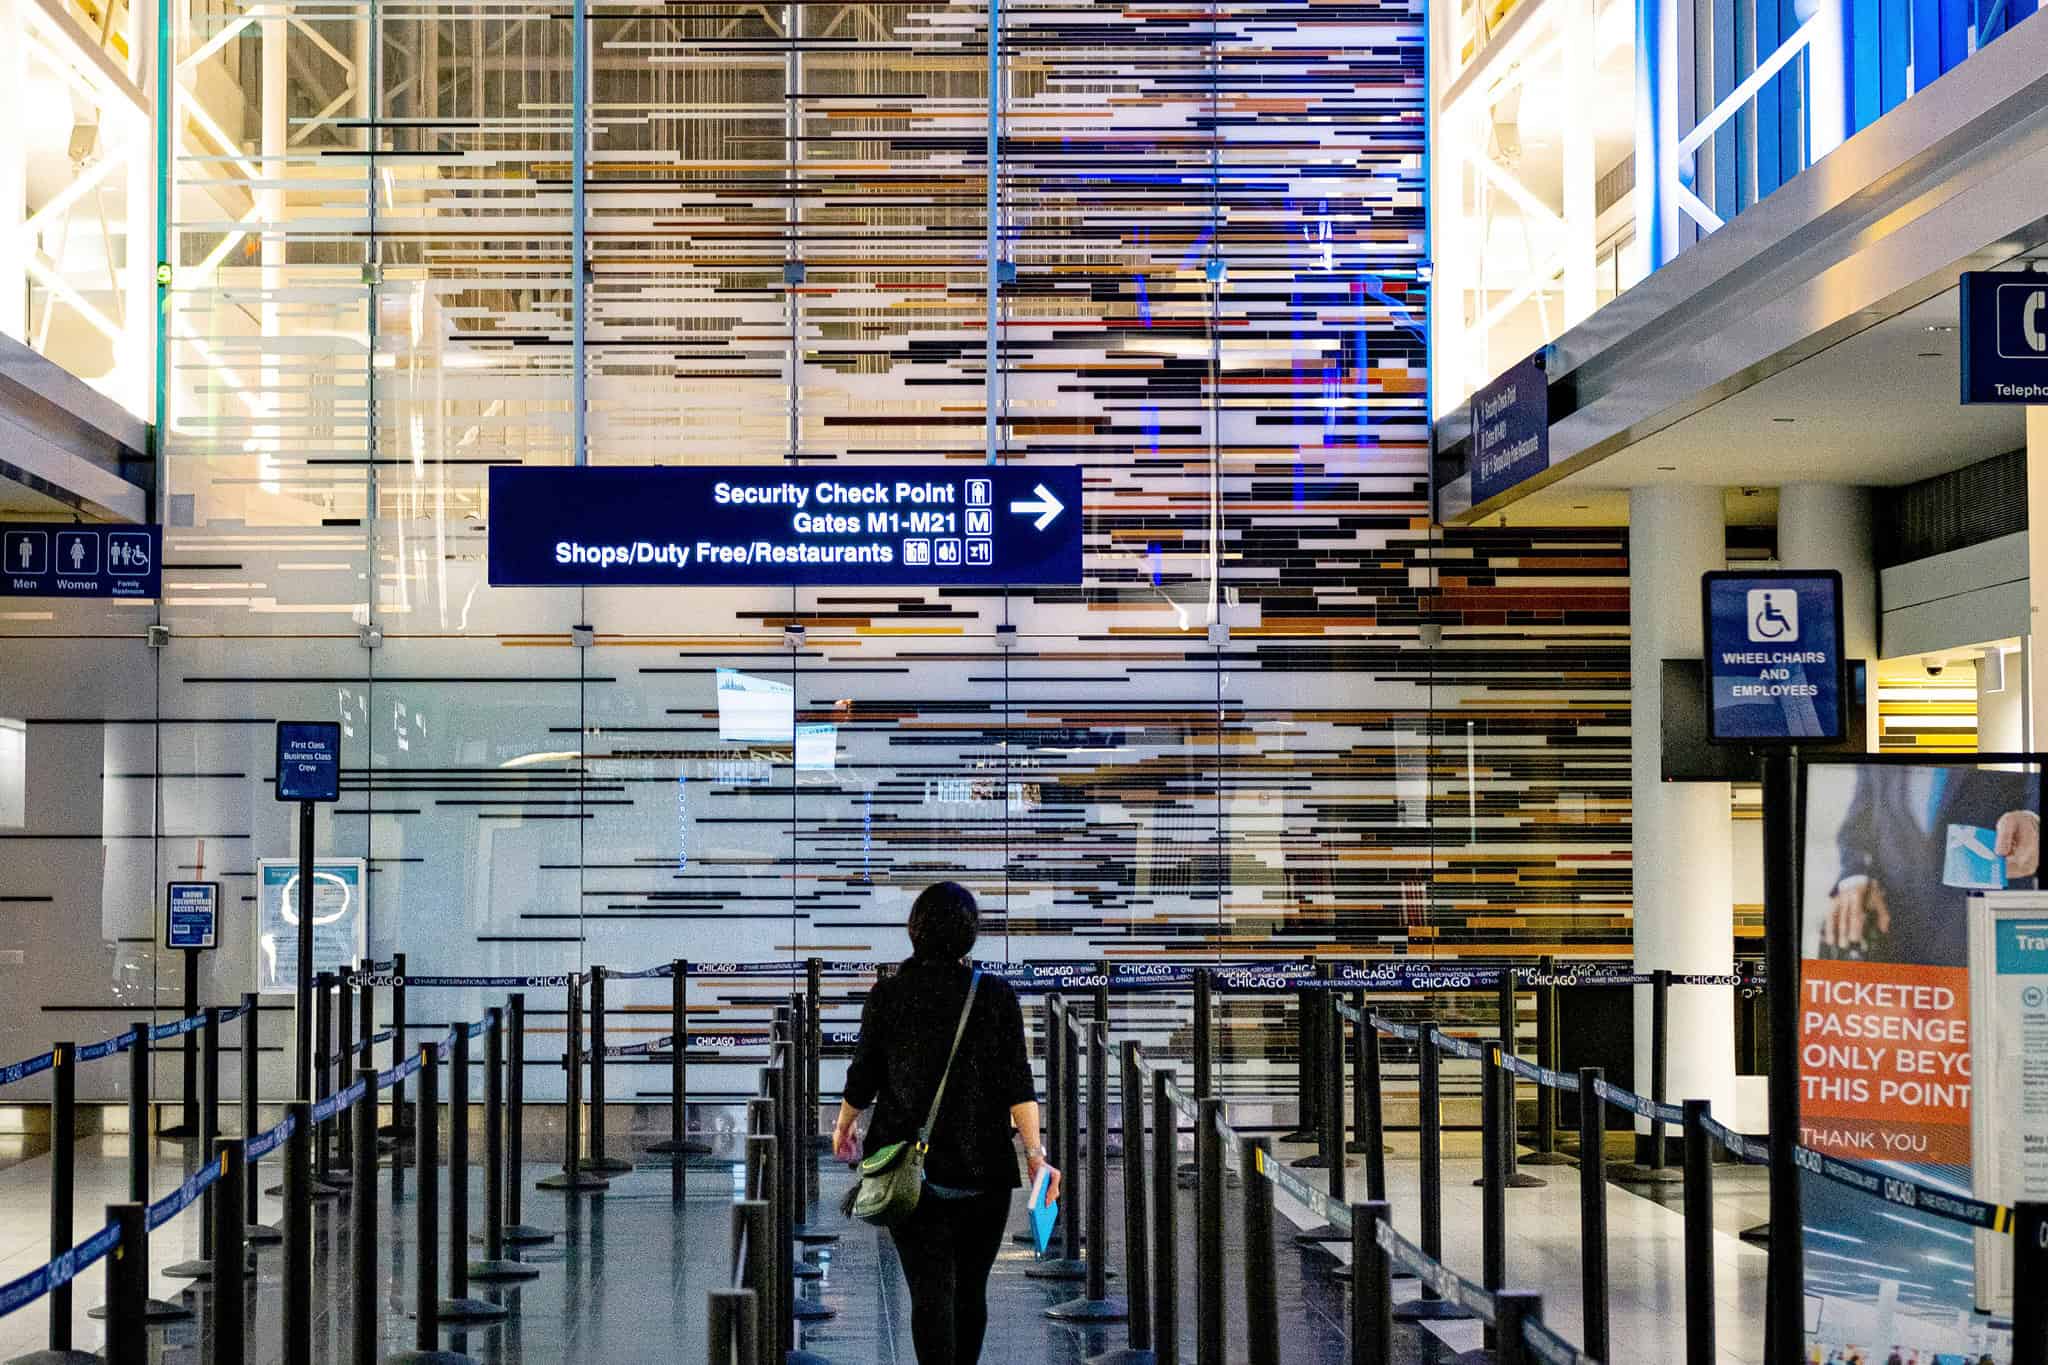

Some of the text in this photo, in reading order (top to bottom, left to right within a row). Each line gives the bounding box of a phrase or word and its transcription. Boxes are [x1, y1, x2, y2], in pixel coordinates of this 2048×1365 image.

[1994, 383, 2048, 398] Telepho
[714, 483, 954, 508] Security Check Point
[793, 513, 956, 534] Gates M1-M21
[555, 542, 893, 568] Shops/Duty Free/Restaurants
[13, 578, 37, 589] Men
[57, 579, 98, 590] Women
[1722, 652, 1826, 664] WHEELCHAIRS
[1759, 668, 1790, 680] AND
[1732, 684, 1818, 697] EMPLOYEES
[291, 741, 326, 749] First Class
[283, 752, 332, 760] Business Class
[298, 763, 317, 772] Crew
[697, 963, 738, 972] CHICAGO
[1033, 965, 1074, 977] CHICAGO
[1119, 965, 1172, 975] CHICAGO
[346, 974, 404, 987] CHICAGO
[439, 977, 488, 985] INTERNATIONAL
[490, 977, 517, 985] AIRPORT
[527, 975, 568, 987] CHICA
[1343, 969, 1396, 980] CHICAGO
[1525, 975, 1577, 986] CHICAGO
[1683, 975, 1741, 986] CHICAGO
[1062, 975, 1108, 987] CHICAGO
[1227, 977, 1286, 988] CHICAGO
[1411, 977, 1471, 989] CHICAGO
[1805, 979, 1955, 1010] TICKETED
[1804, 1012, 1967, 1044] PASSENGE
[696, 1036, 736, 1047] CHICAGO
[832, 1032, 858, 1043] CHIC
[1802, 1044, 1886, 1071] ONLY
[1802, 1076, 1972, 1108] THIS POINT
[1800, 1127, 1927, 1153] THANK YOU
